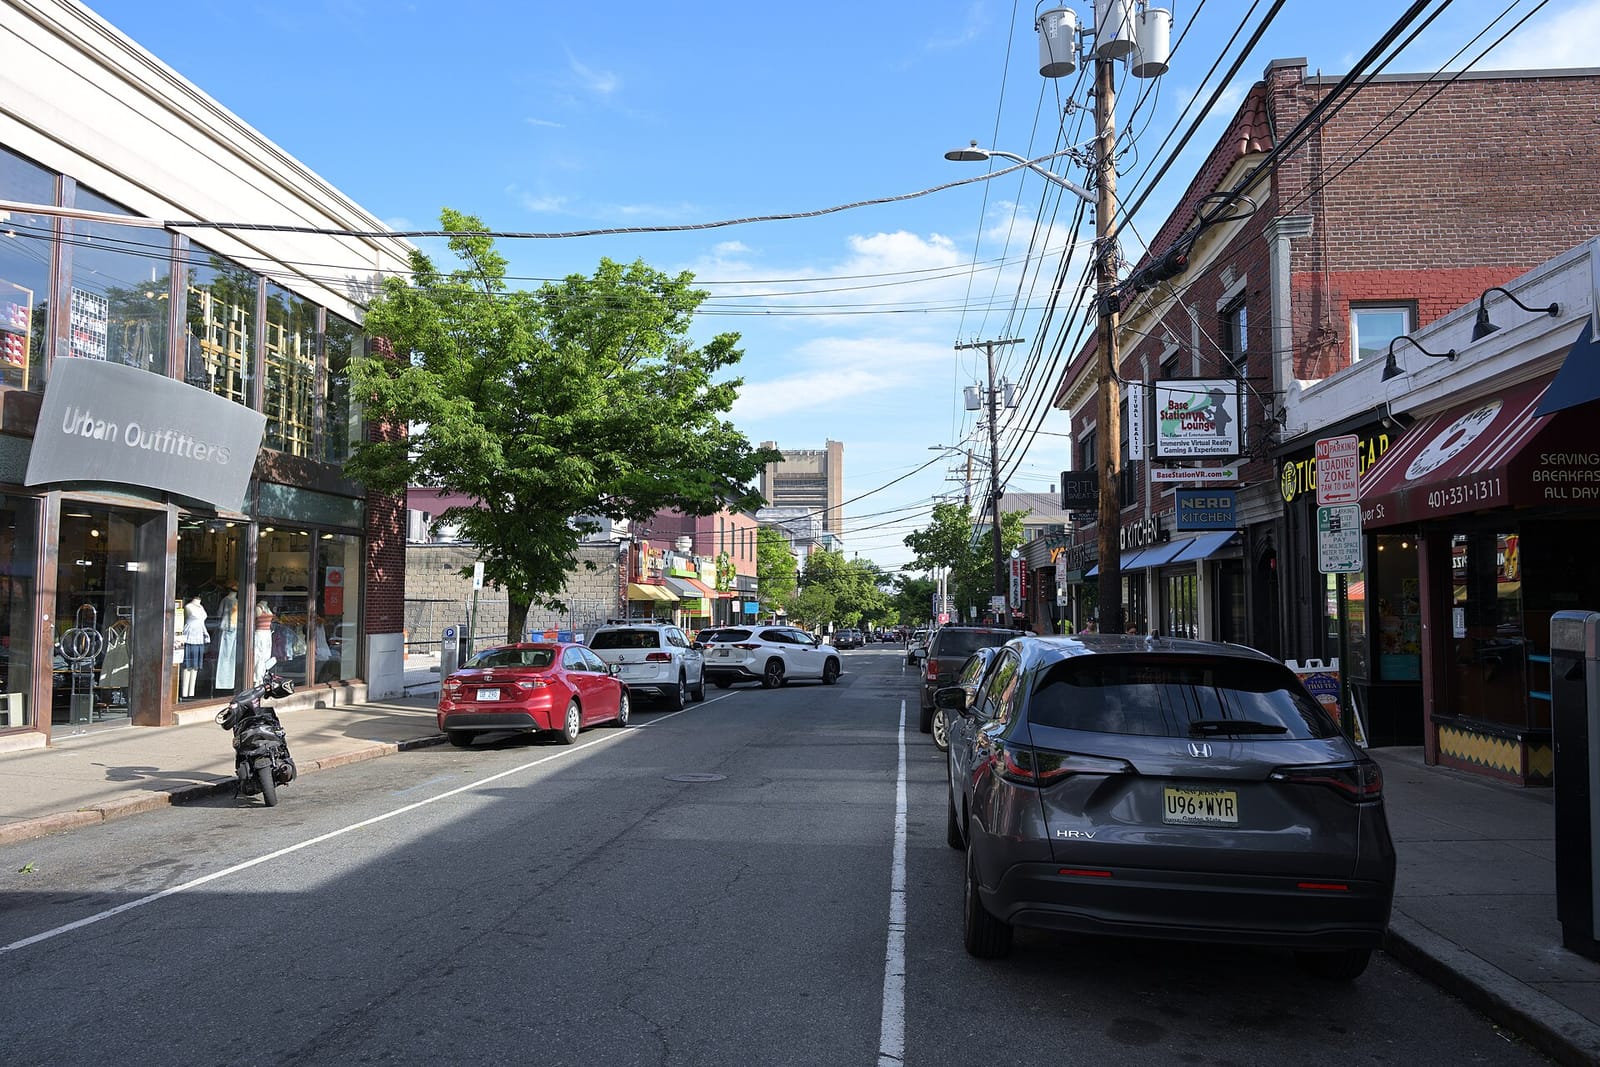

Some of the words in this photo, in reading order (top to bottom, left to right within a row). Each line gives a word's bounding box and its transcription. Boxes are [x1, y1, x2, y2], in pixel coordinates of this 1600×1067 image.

[1168, 400, 1188, 410] Base
[1181, 421, 1216, 432] Lounge
[62, 406, 118, 442] Urban
[124, 422, 231, 464] Outfitters
[1318, 443, 1328, 456] NO
[1330, 442, 1356, 453] PARKING
[1321, 458, 1354, 471] LOADING
[1540, 453, 1600, 465] SERVING
[1156, 471, 1222, 479] BaseStationVR.com
[1325, 470, 1351, 482] ZONE
[1321, 484, 1332, 492] 7AM
[1544, 487, 1568, 499] ALL
[1572, 487, 1599, 499] DAY
[1182, 512, 1232, 522] KITCHEN
[1322, 510, 1328, 522] 3
[1376, 504, 1384, 519] St
[1128, 514, 1158, 548] KITCHEN
[1168, 796, 1195, 814] U96
[1206, 797, 1234, 816] WYR
[1056, 830, 1096, 839] HR-V
